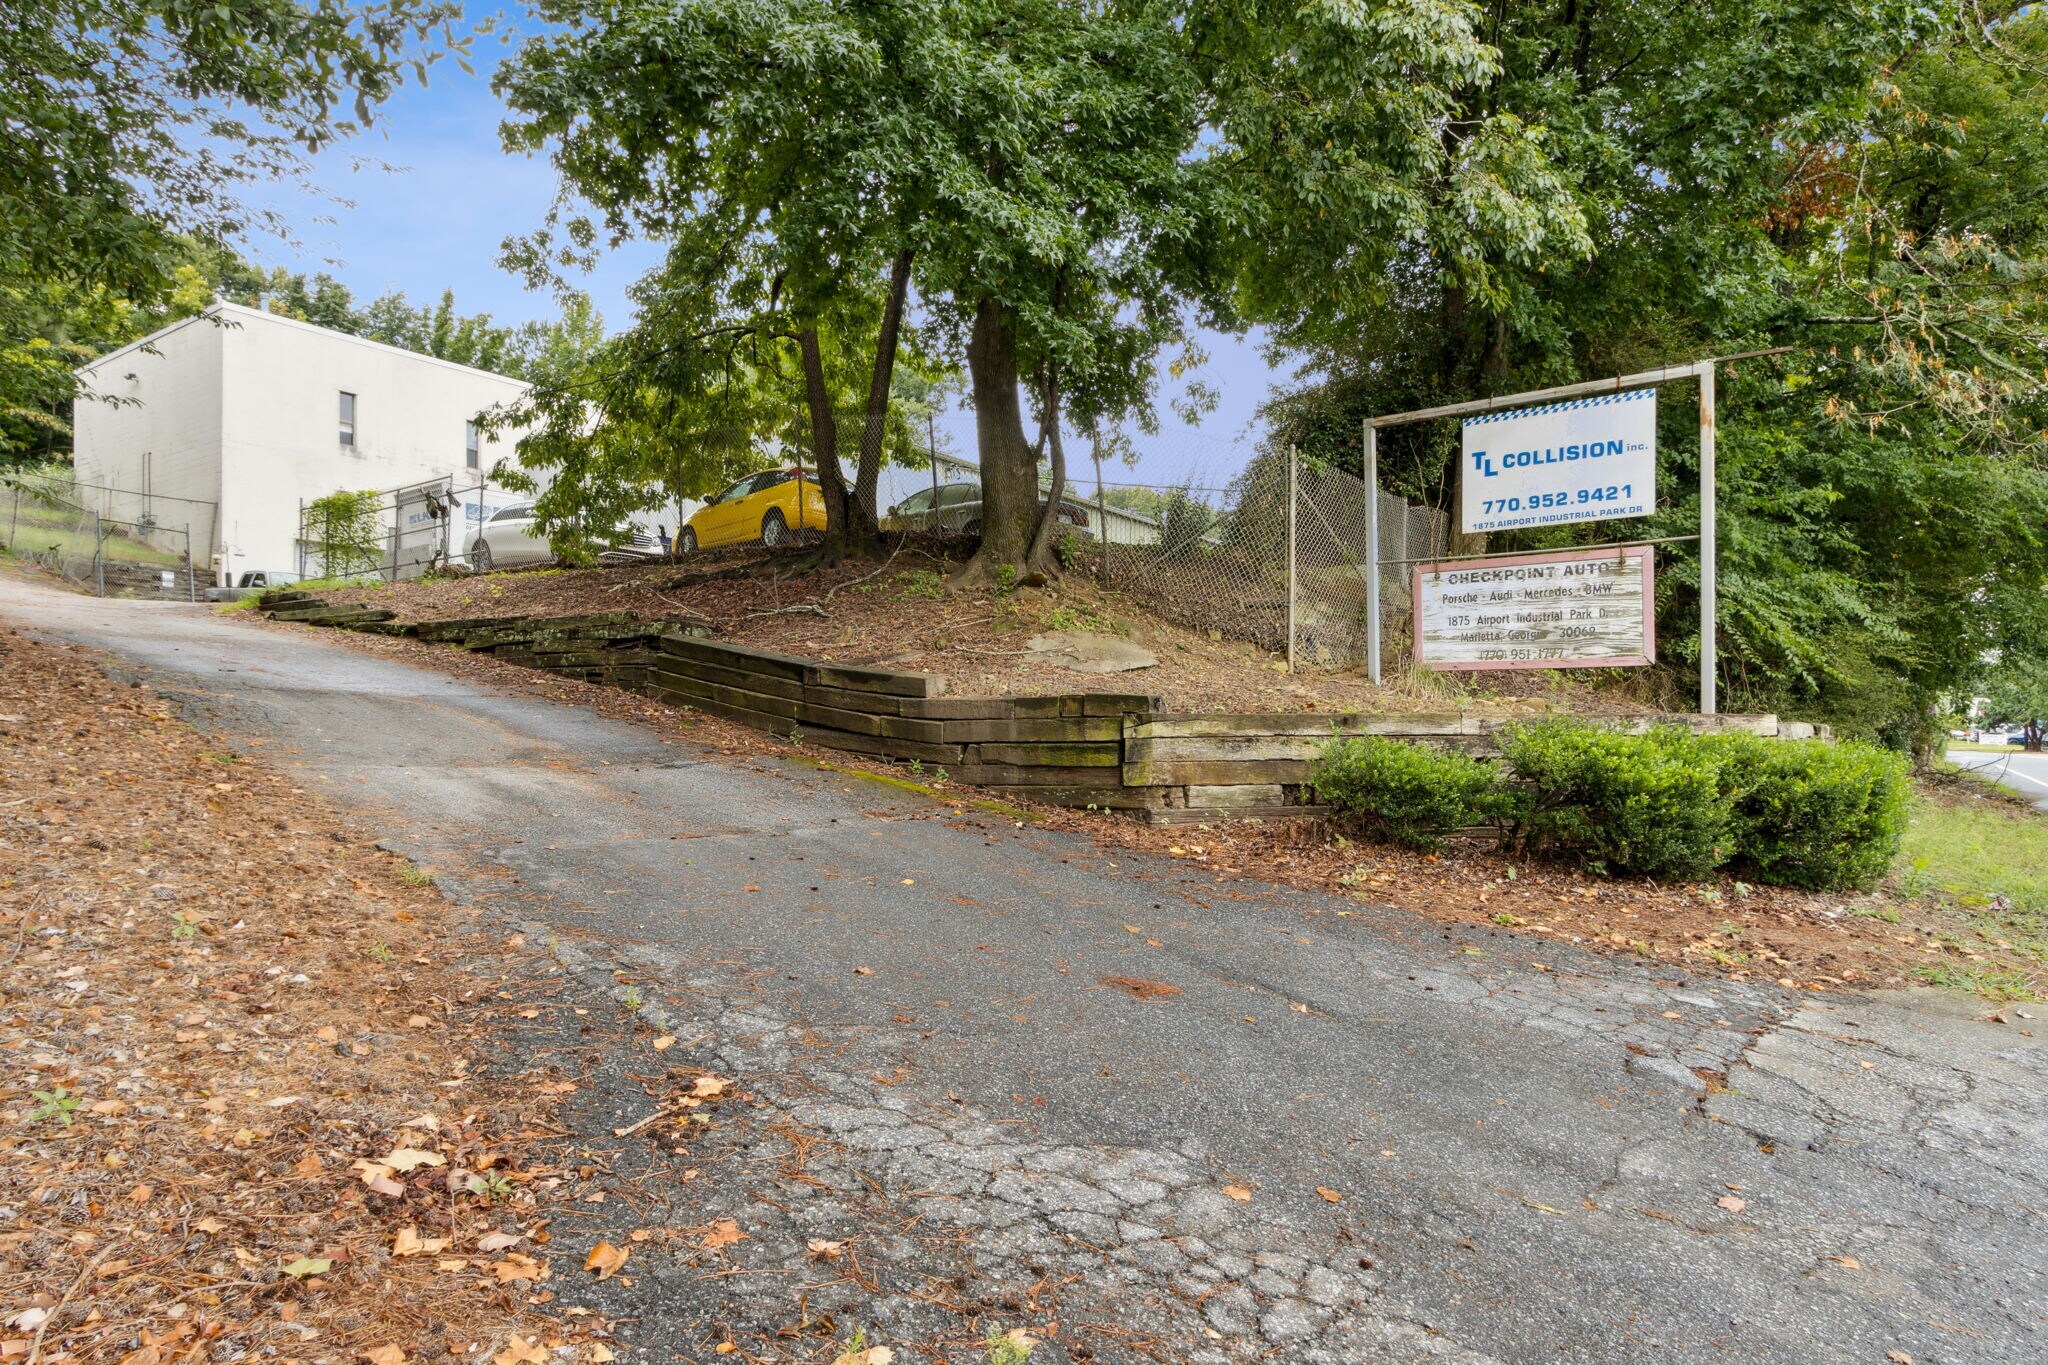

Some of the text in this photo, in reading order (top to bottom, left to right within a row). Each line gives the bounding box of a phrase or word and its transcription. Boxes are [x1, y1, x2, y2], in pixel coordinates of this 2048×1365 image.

[1472, 440, 1648, 477] TL COLLISION inc.
[1482, 484, 1632, 515] 770.952.9421
[1472, 521, 1495, 530] 1875
[1497, 517, 1537, 528] AIRPORT
[1539, 511, 1597, 522] INDUSTRIAL
[1599, 507, 1627, 517] PARK
[1448, 562, 1610, 585] CHECKPOINT AUTO
[1442, 592, 1478, 604] Porsche
[1489, 590, 1513, 601] Audi
[1524, 586, 1573, 599] Mercedes
[1585, 582, 1614, 595] BMW
[1448, 615, 1470, 626] 1875
[1476, 614, 1510, 627] Airport
[1516, 611, 1563, 622] Industrial
[1570, 608, 1592, 620] Park
